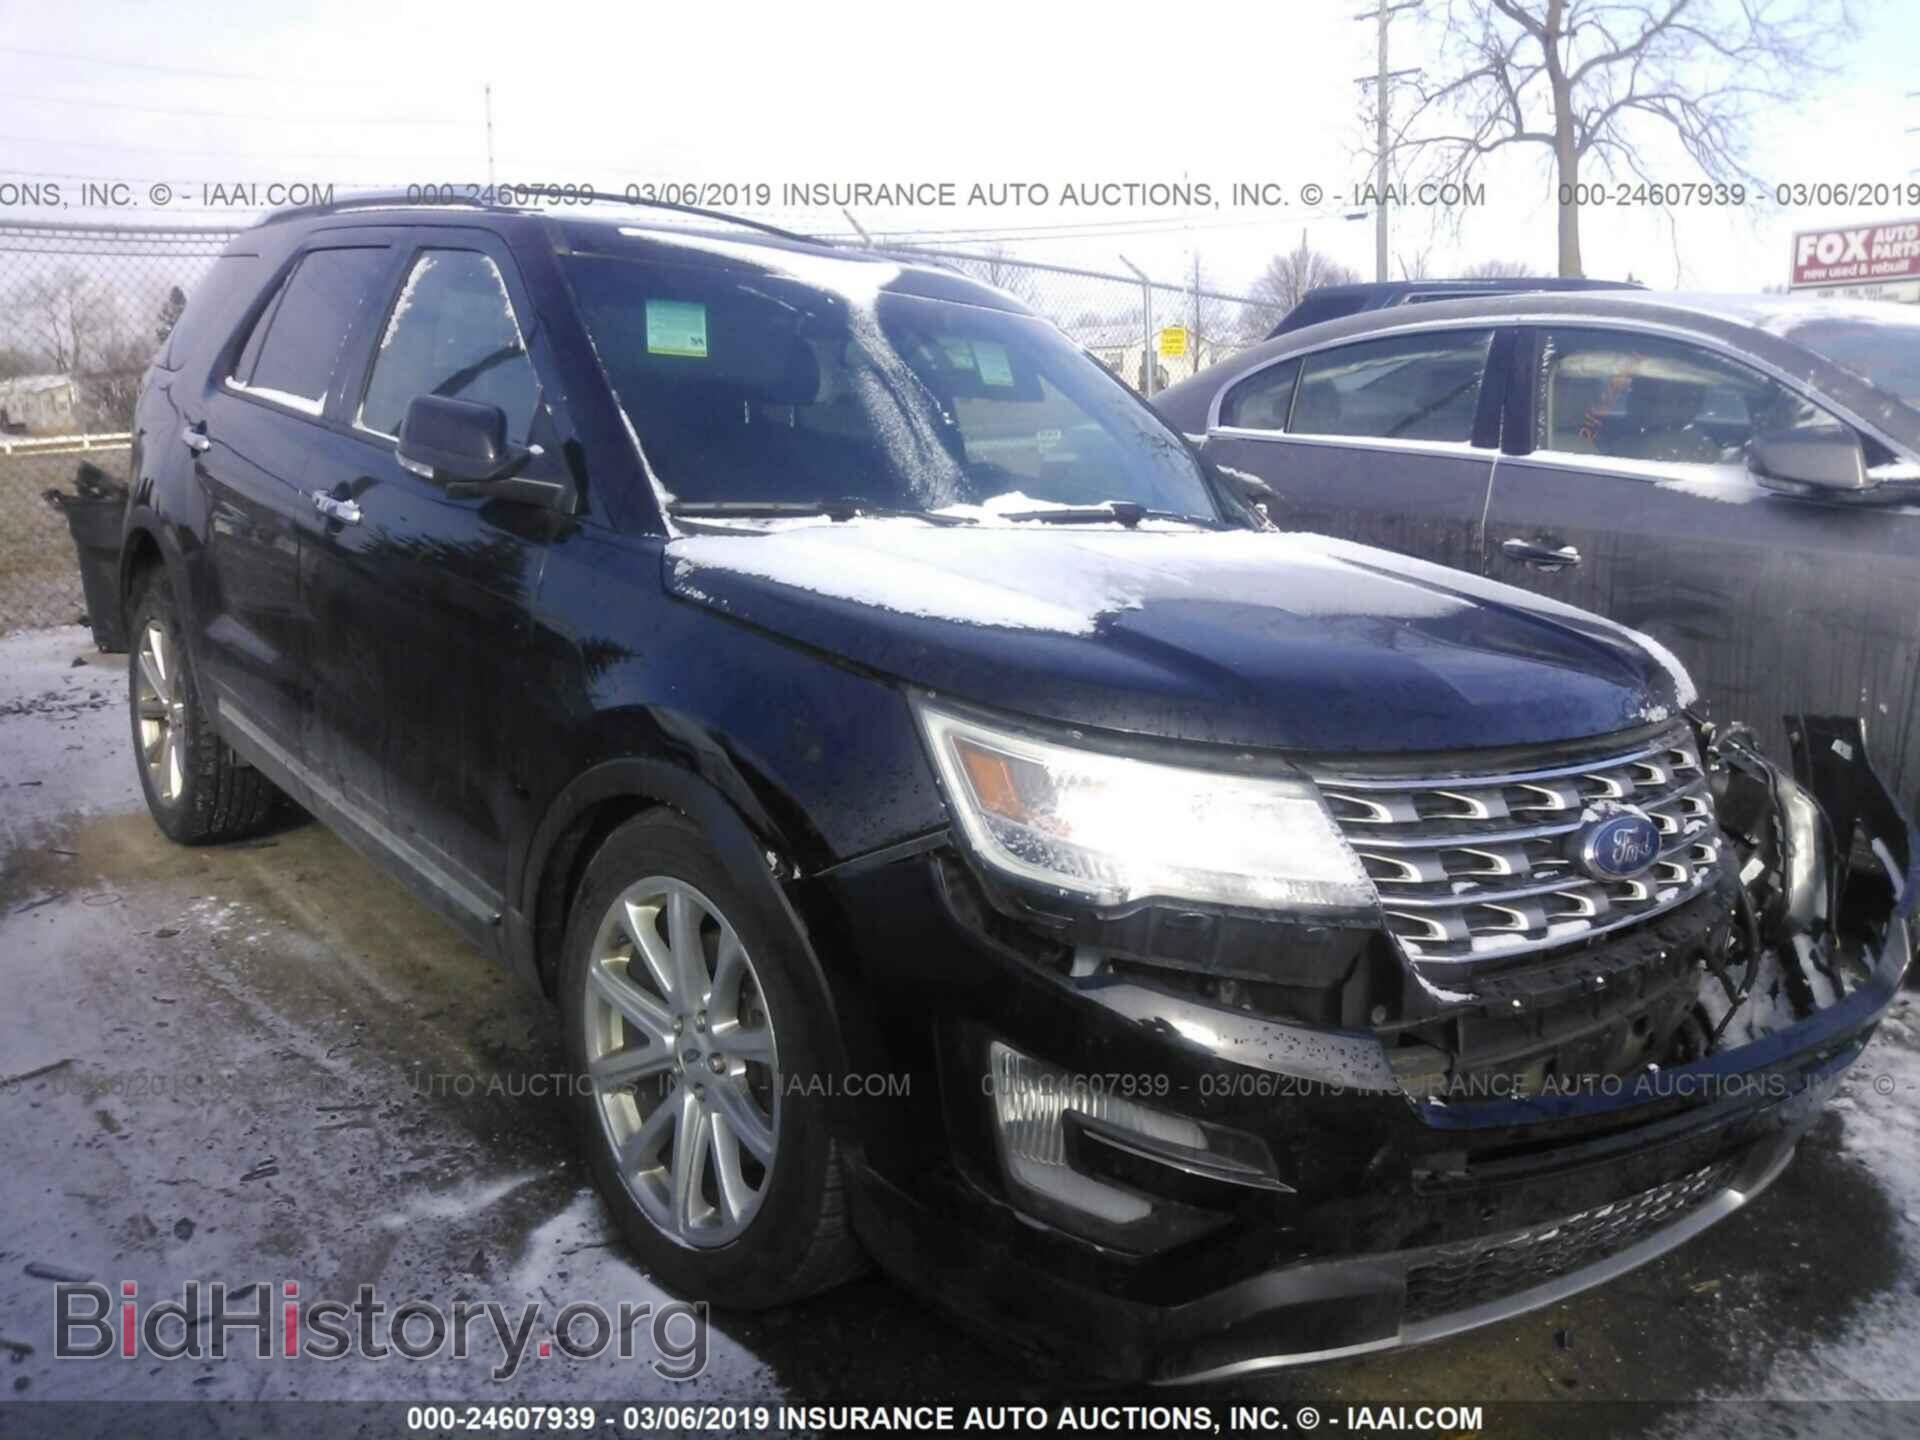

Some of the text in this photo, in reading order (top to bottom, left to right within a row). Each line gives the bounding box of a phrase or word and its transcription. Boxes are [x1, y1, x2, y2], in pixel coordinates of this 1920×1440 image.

[1874, 224, 1918, 242] AUTO
[1797, 230, 1871, 266] FOX
[1828, 264, 1857, 279] used
[1612, 827, 1651, 864] Ford
